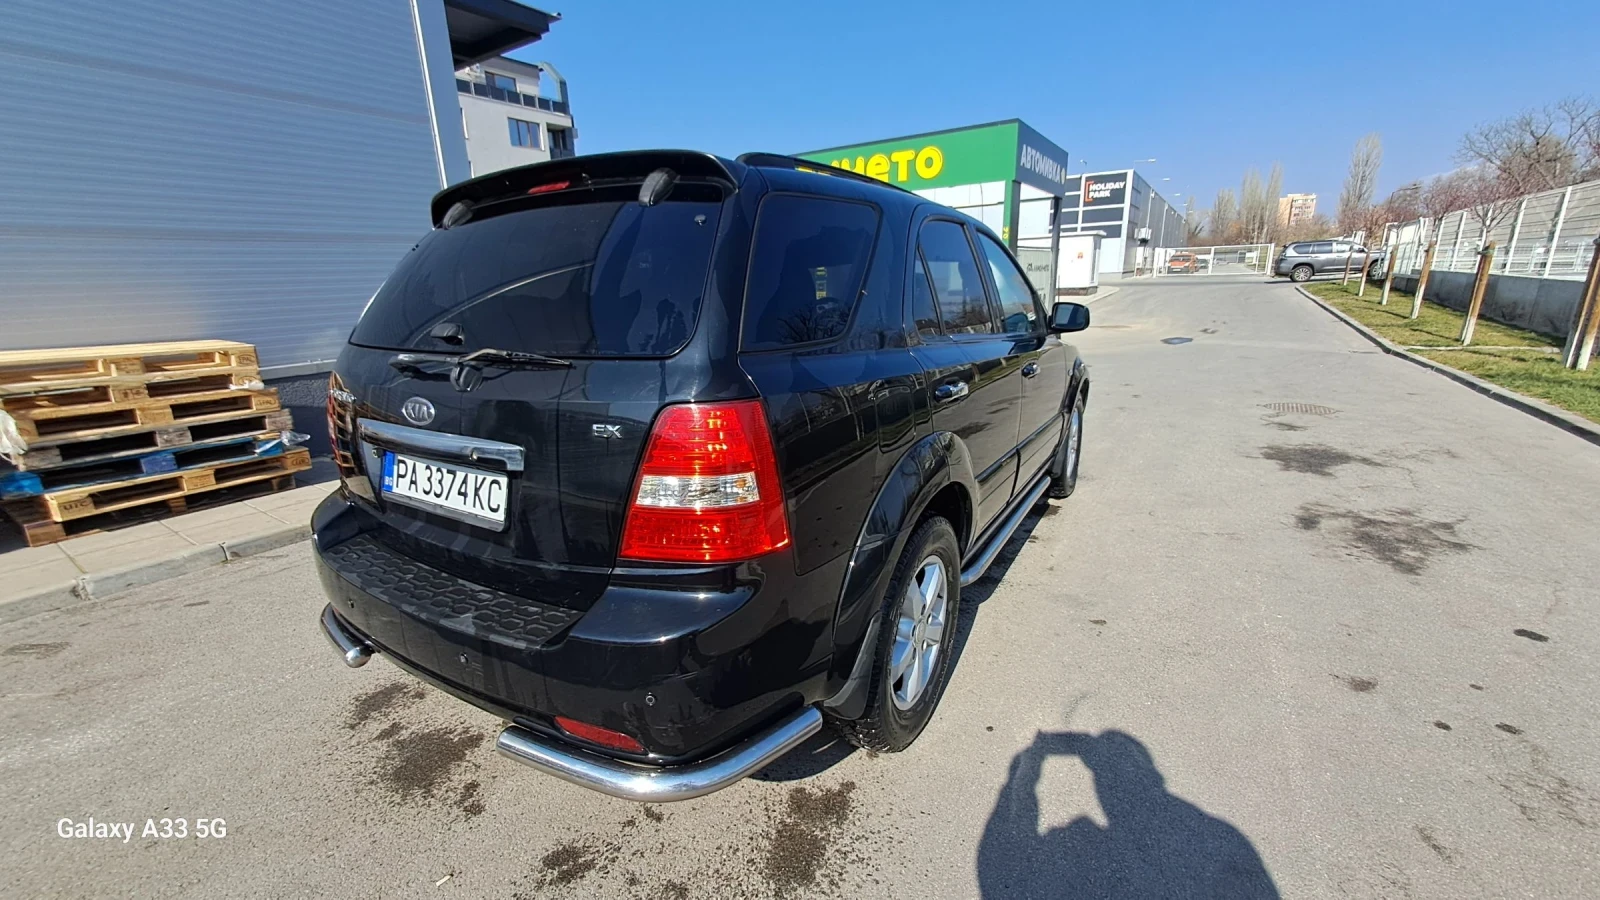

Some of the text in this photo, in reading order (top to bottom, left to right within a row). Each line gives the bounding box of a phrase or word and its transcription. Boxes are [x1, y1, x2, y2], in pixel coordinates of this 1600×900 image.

[1020, 144, 1061, 183] АВТОМИВКА
[1088, 181, 1126, 191] HOLIDAY
[1088, 190, 1111, 199] PARK
[405, 401, 431, 421] KIA
[592, 424, 623, 439] EX
